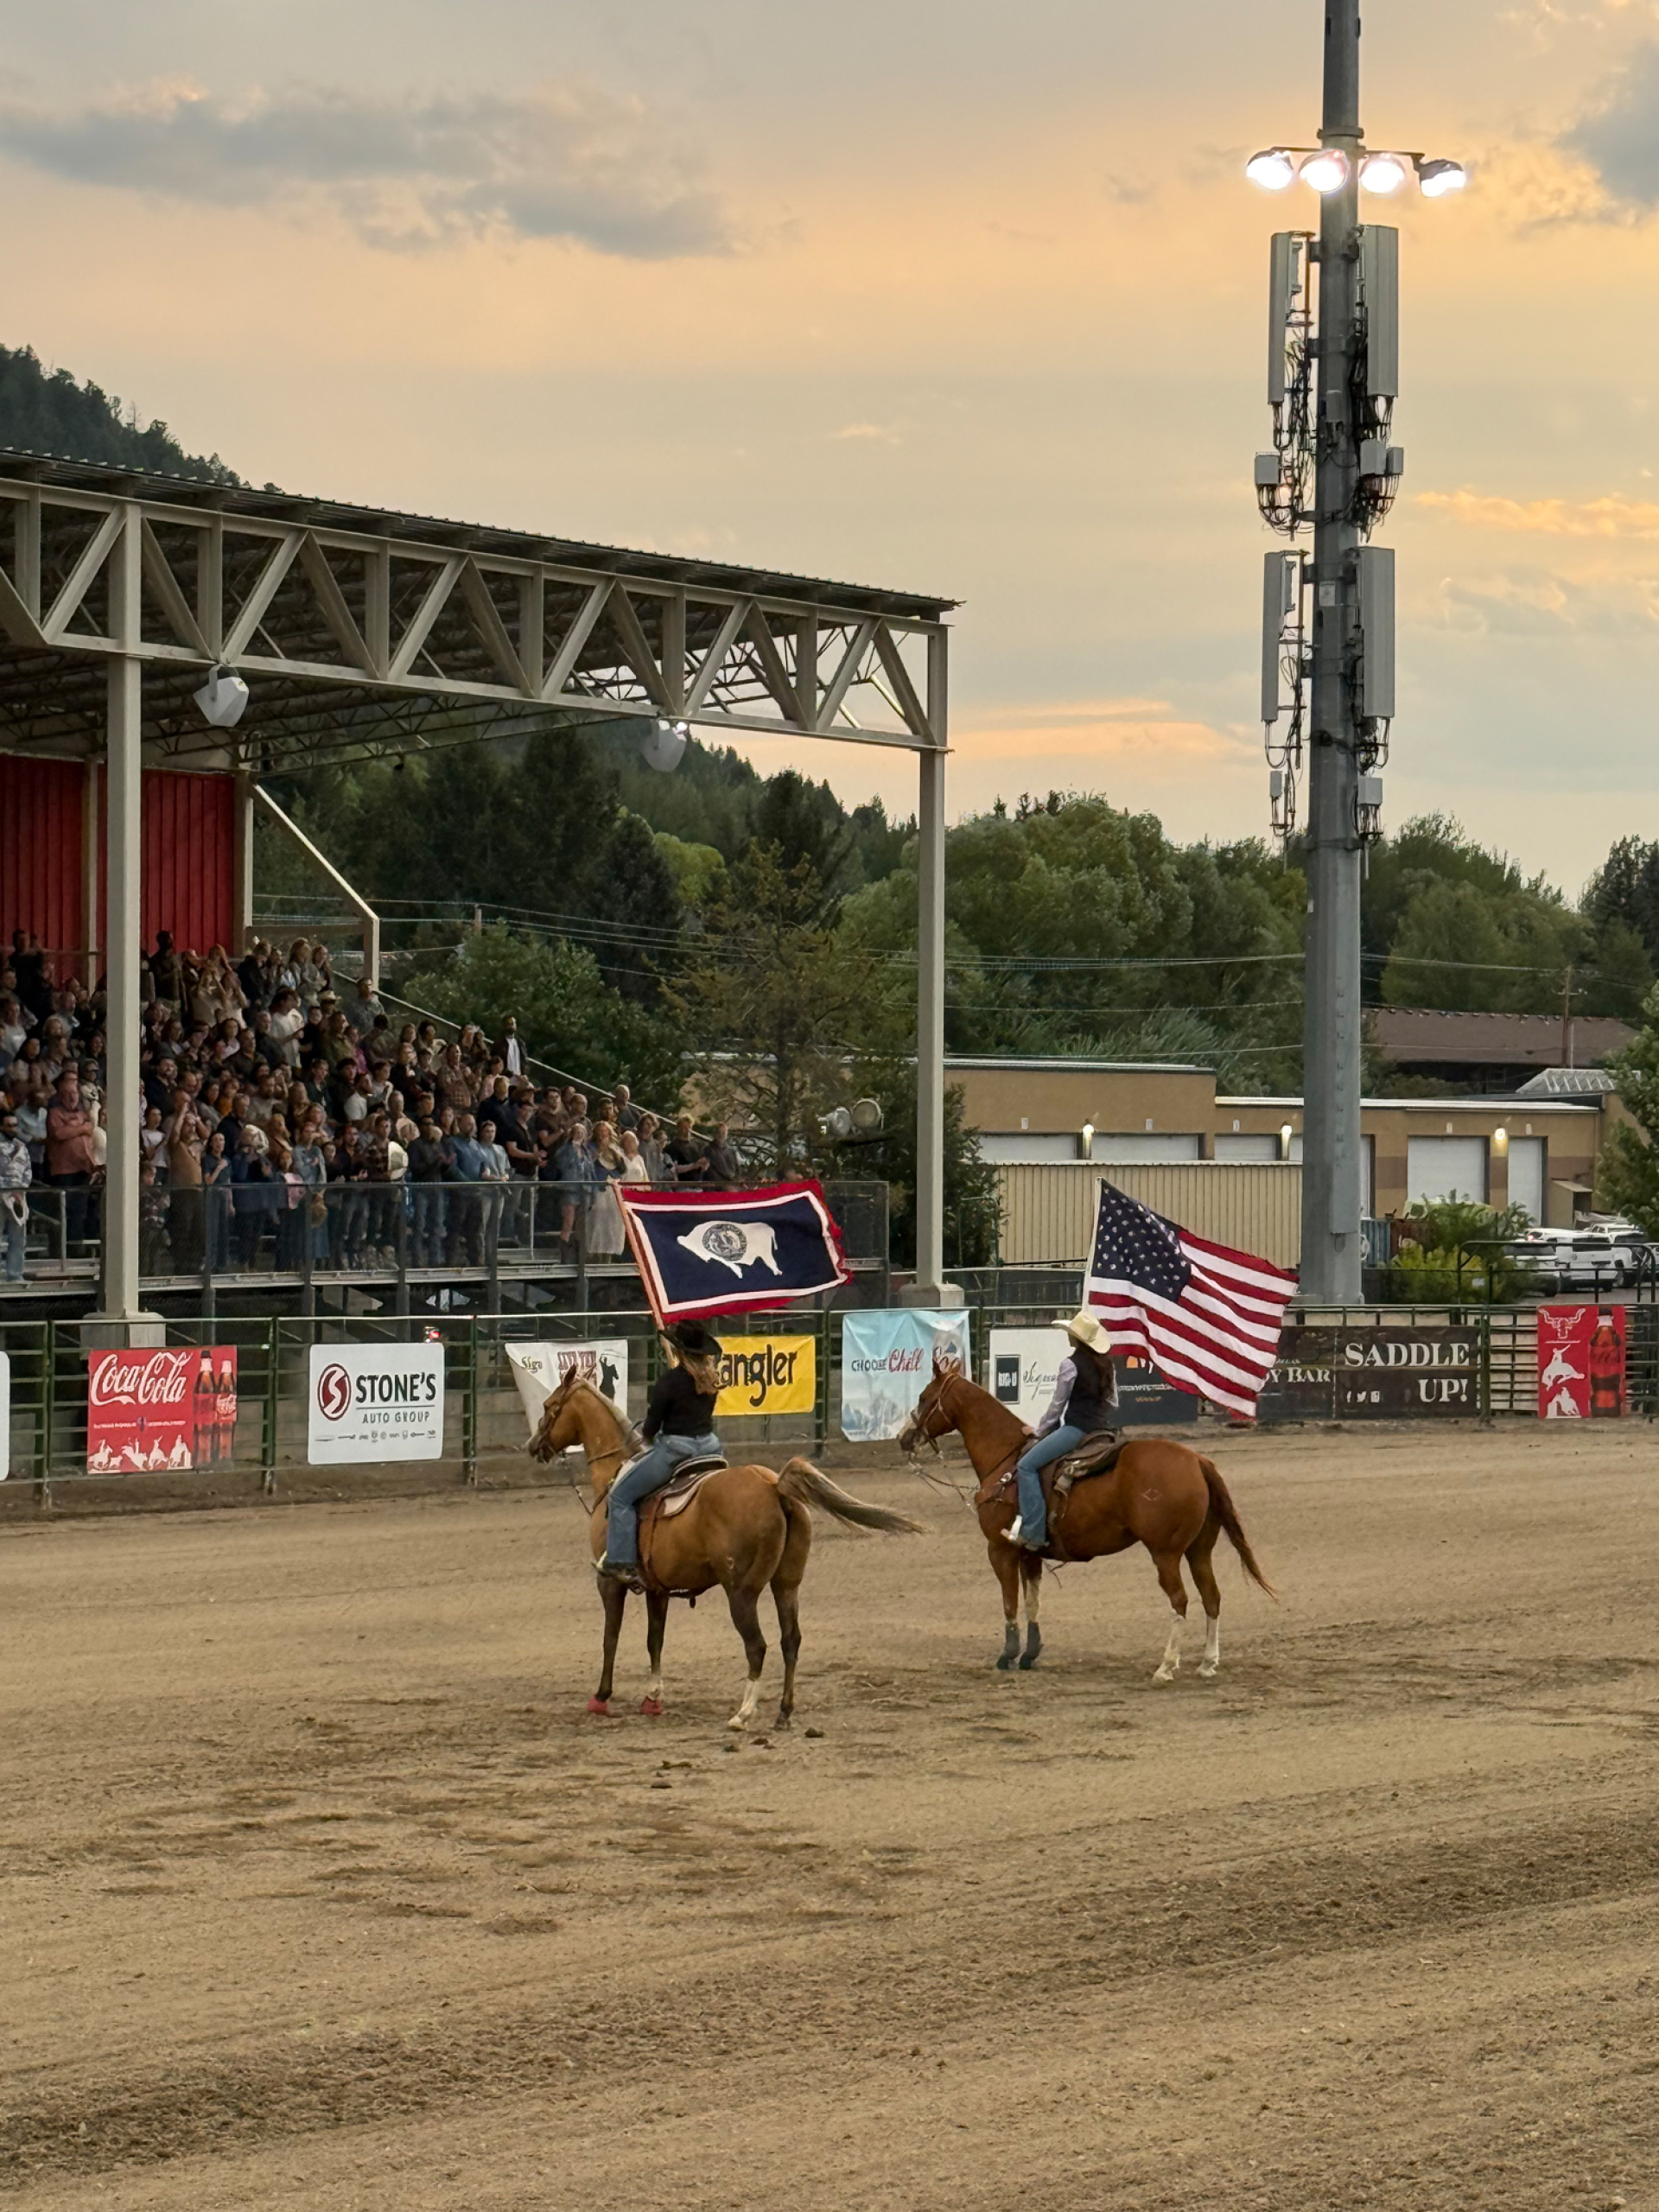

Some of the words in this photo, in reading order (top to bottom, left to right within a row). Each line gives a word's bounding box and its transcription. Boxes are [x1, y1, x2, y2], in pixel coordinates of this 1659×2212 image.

[888, 1347, 925, 1373] Chill
[1344, 1343, 1469, 1367] SADDLE
[90, 1351, 194, 1407] Coca-Cola
[355, 1372, 436, 1403] STONE'S
[721, 1344, 798, 1408] angler
[1287, 1367, 1331, 1383] BAR
[1418, 1378, 1469, 1403] UP!
[362, 1412, 390, 1425] AUTO
[395, 1410, 430, 1423] GROUP
